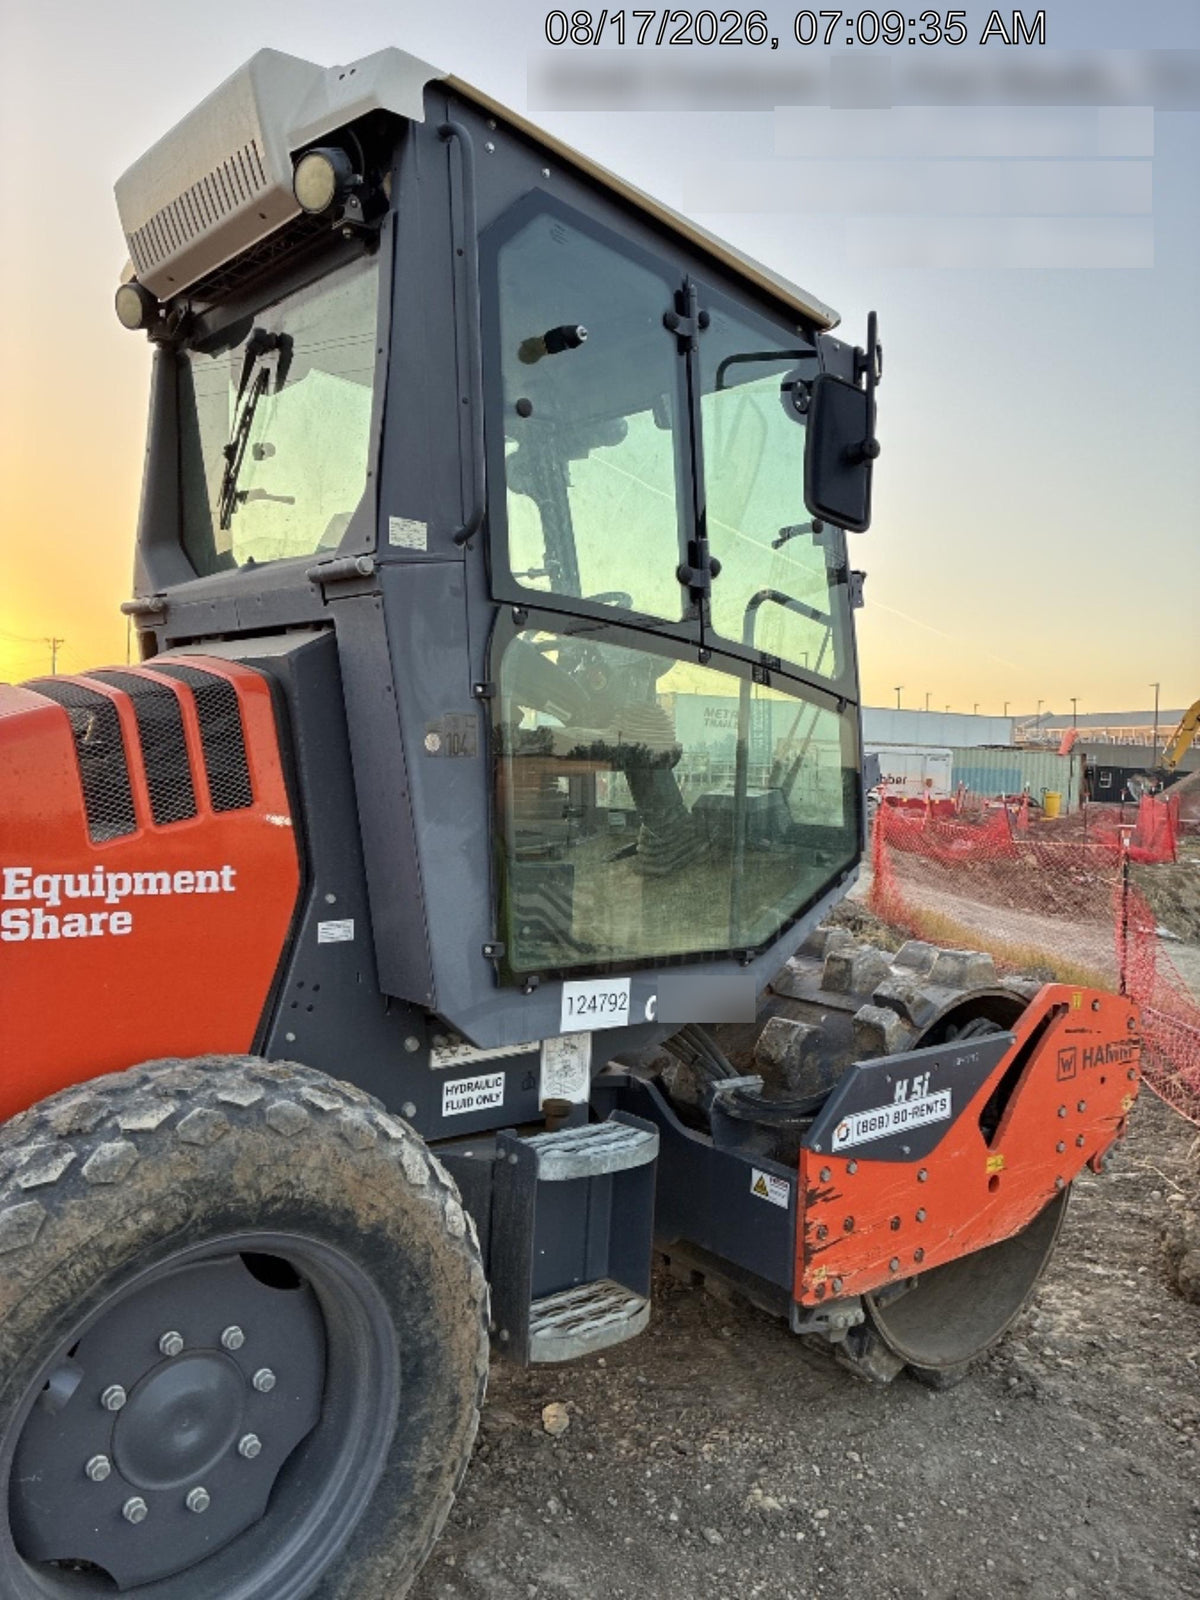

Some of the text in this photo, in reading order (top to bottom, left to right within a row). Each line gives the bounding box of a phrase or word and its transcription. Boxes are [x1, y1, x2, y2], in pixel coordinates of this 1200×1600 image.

[2, 866, 236, 906] Equipment
[0, 908, 133, 941] Share
[567, 991, 629, 1016] 124792
[445, 1076, 502, 1096] HYDRAULIC
[445, 1091, 502, 1112] FLUID ONLY
[892, 1098, 947, 1125] 80-RENTS
